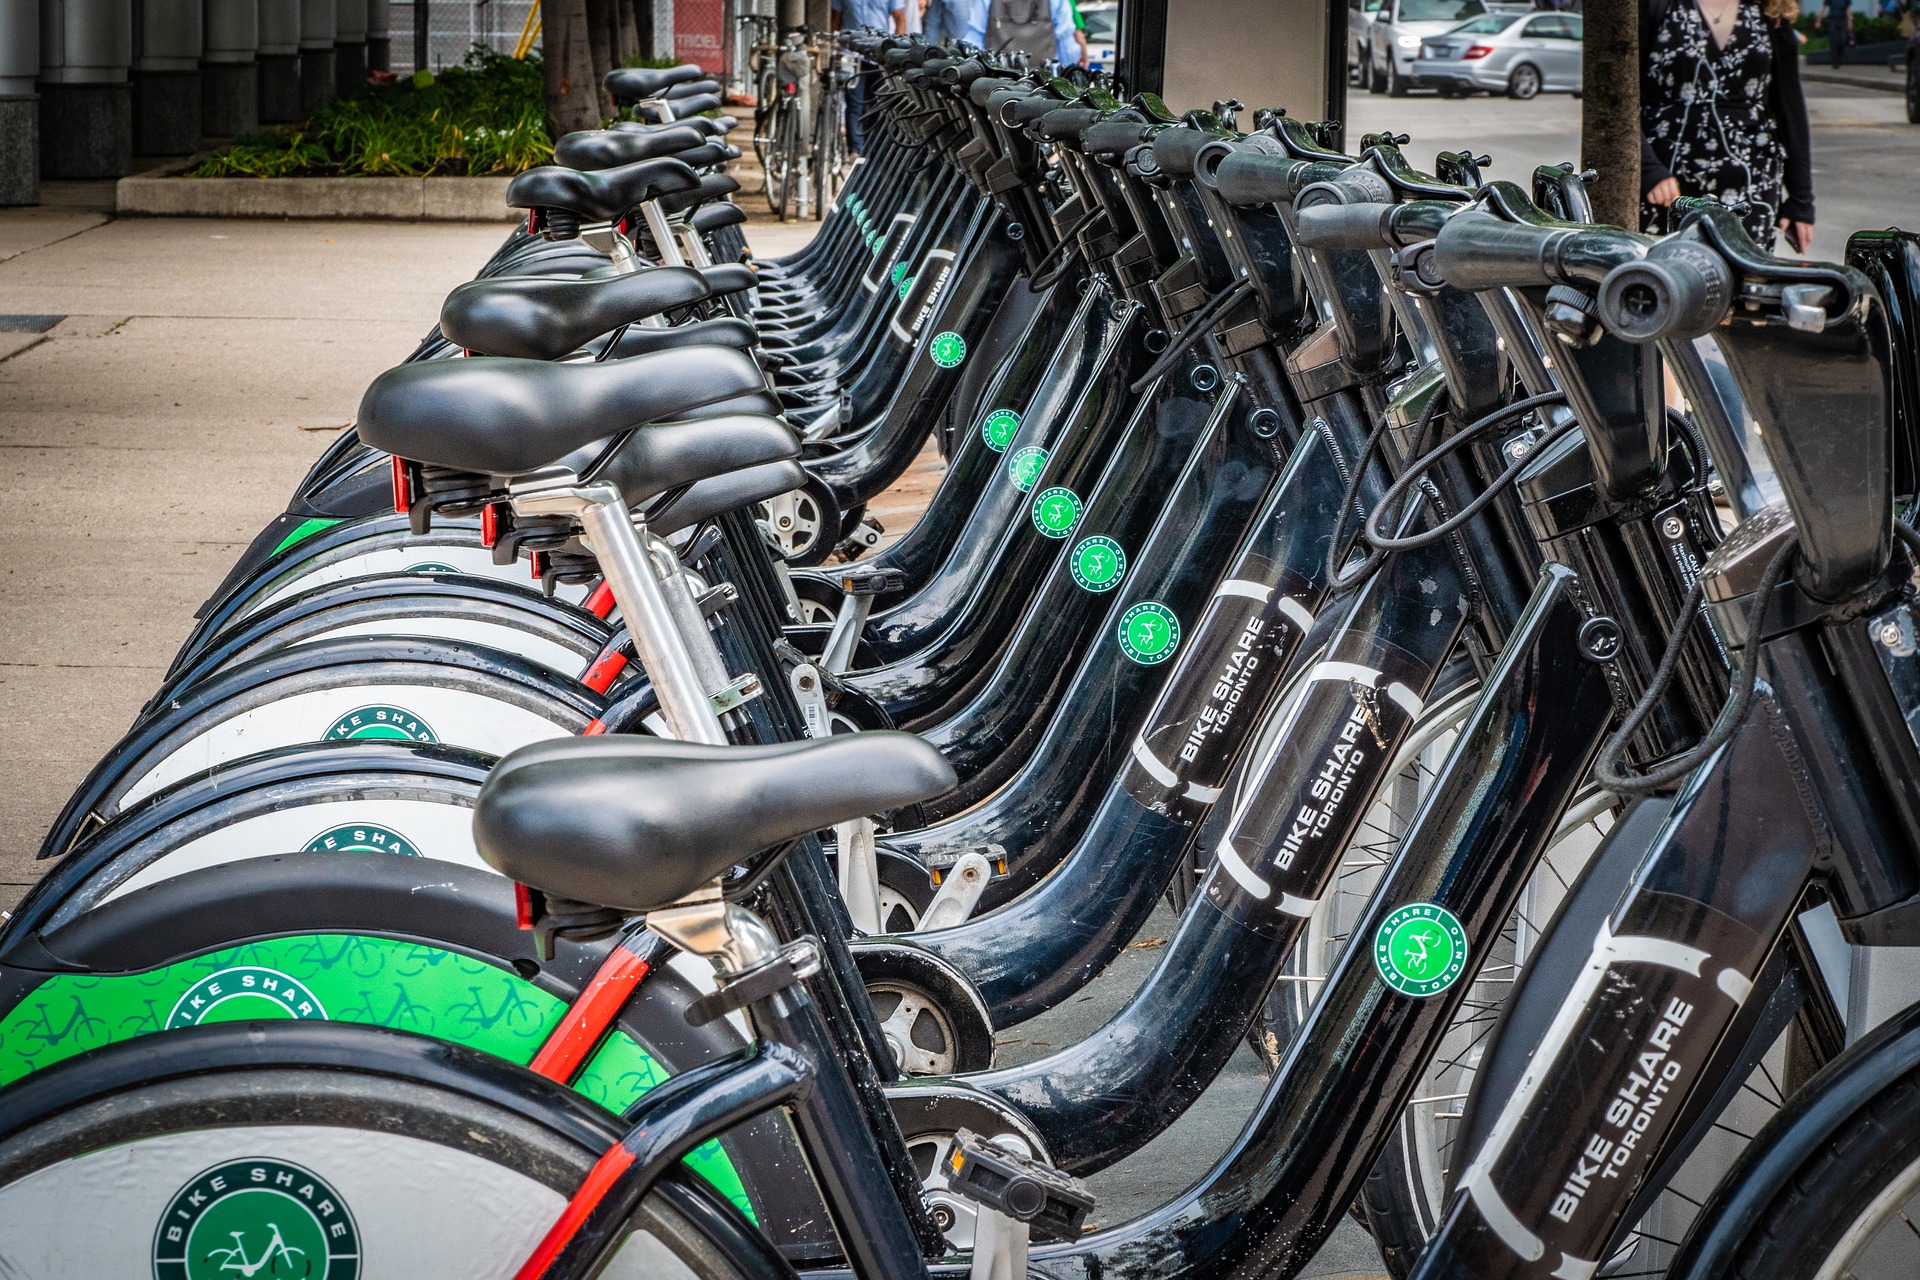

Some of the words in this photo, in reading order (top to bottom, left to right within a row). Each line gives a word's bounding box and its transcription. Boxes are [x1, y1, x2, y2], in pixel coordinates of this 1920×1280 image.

[911, 304, 930, 332] BIKE
[927, 265, 951, 304] SHARE
[1037, 490, 1063, 504] SHARE
[1076, 539, 1104, 556] SHARE
[1676, 559, 1685, 573] child
[1677, 542, 1692, 573] Maximum
[1687, 553, 1701, 575] CAUT
[1073, 561, 1085, 583] BIKE
[1098, 549, 1124, 589] TORONTO
[1124, 605, 1156, 623] SHARE
[1120, 630, 1134, 655] BIKE
[1148, 617, 1178, 661] TORONTO
[1180, 704, 1219, 763] BIKE
[1212, 615, 1265, 701] SHARE
[1211, 656, 1259, 735] TORONTO
[329, 716, 362, 741] KE
[376, 711, 430, 742] SHAR
[1273, 804, 1317, 871] BIKE
[1310, 704, 1370, 801] SHARE
[1310, 750, 1365, 839] TORONTO
[354, 830, 412, 857] SHA
[1384, 908, 1432, 935] SHARE
[1379, 945, 1398, 981] BIKE
[1420, 927, 1463, 991] TORONTO
[175, 982, 222, 1029] IKE
[242, 975, 313, 1016] SHAR
[1549, 1133, 1614, 1224] BIKE
[1604, 996, 1694, 1129] SHARE
[1601, 1060, 1682, 1181] TORONTO
[166, 1175, 228, 1242] BIKE
[250, 1167, 348, 1239] SHARE
